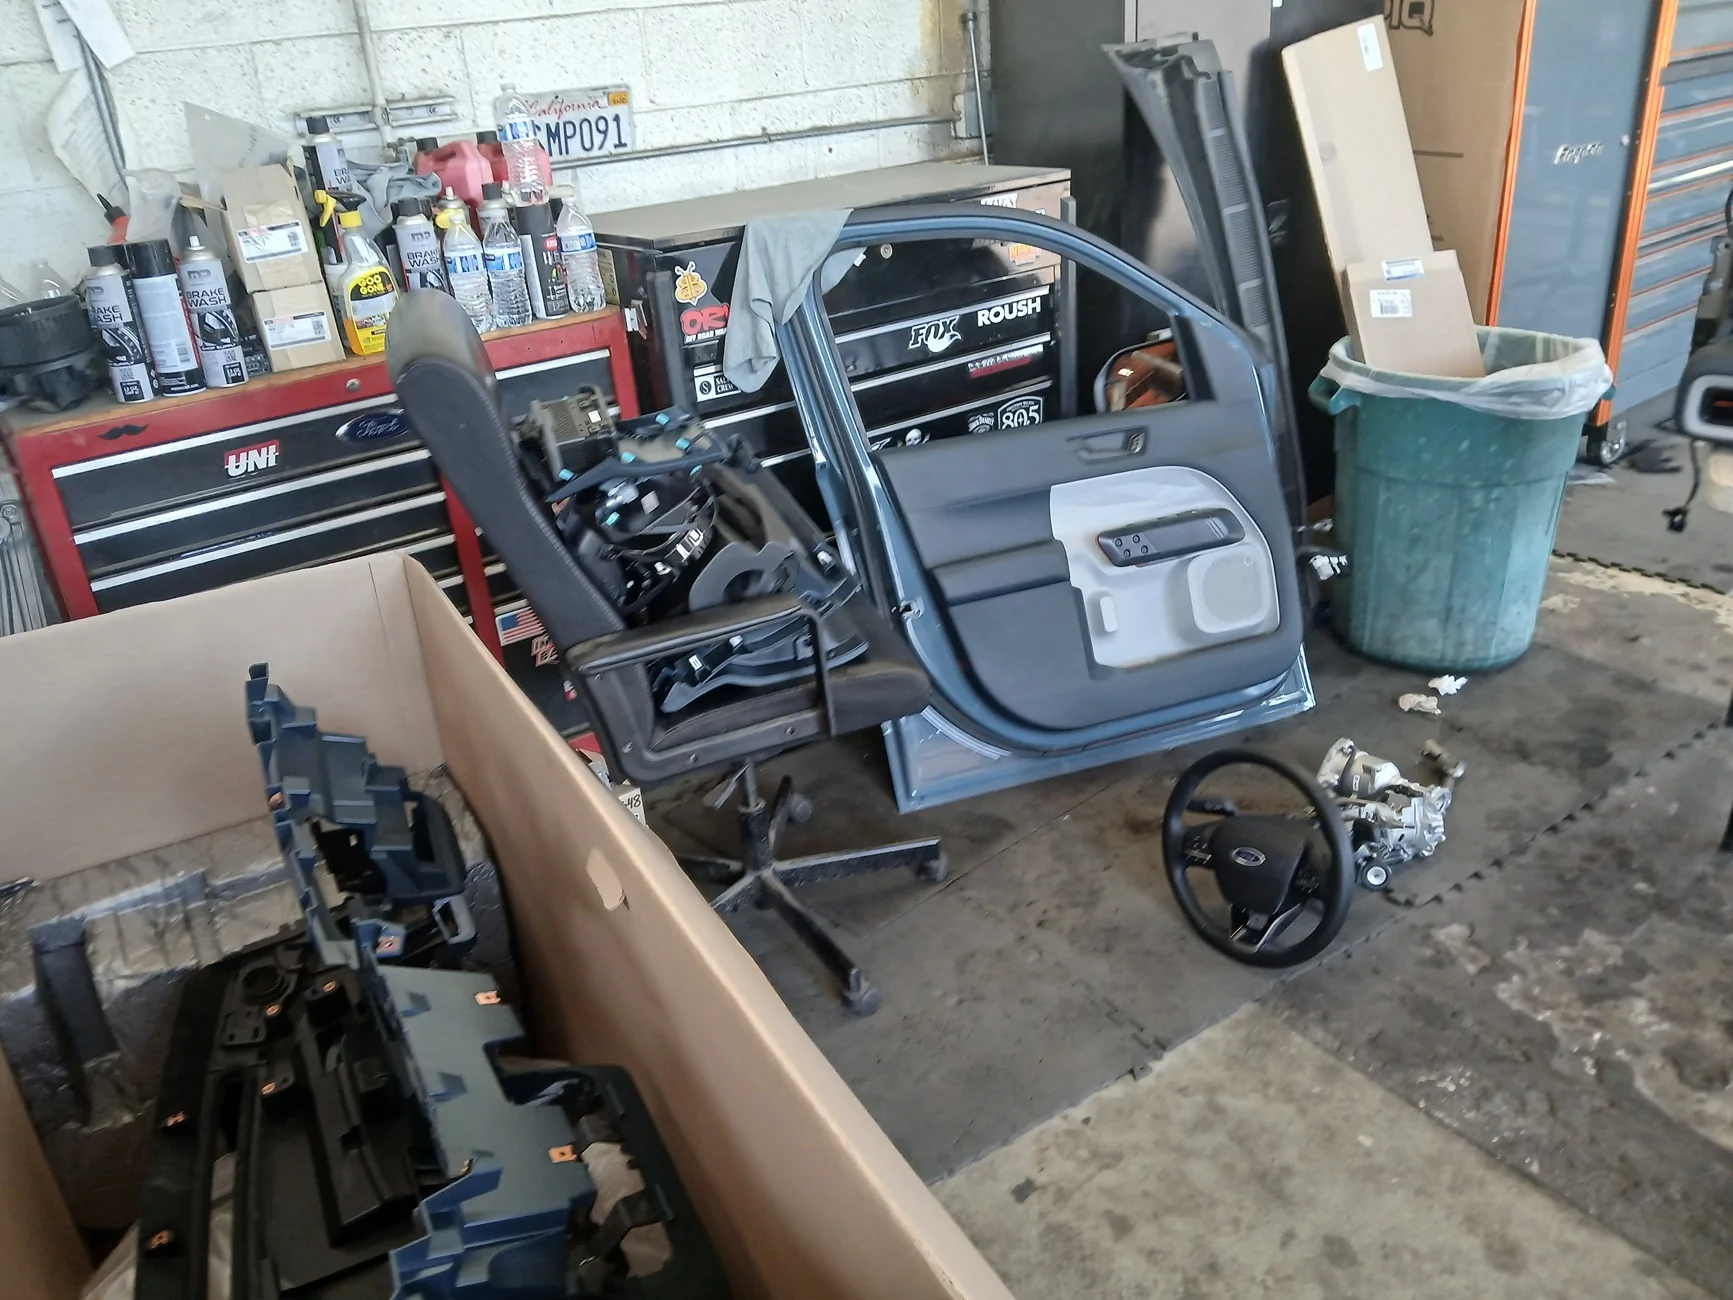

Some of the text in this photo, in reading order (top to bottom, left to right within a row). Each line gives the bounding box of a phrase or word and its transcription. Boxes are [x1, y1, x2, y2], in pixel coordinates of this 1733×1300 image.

[358, 274, 382, 288] GOO
[185, 287, 225, 299] BRAKE
[360, 283, 386, 295] GONE
[187, 295, 227, 308] WASH
[96, 312, 123, 323] ASH
[977, 297, 1042, 327] ROUSH
[697, 330, 714, 340] ROAD
[909, 315, 962, 352] FOX
[1002, 404, 1040, 429] 805
[357, 416, 400, 437] Ford
[225, 444, 279, 477] UNI
